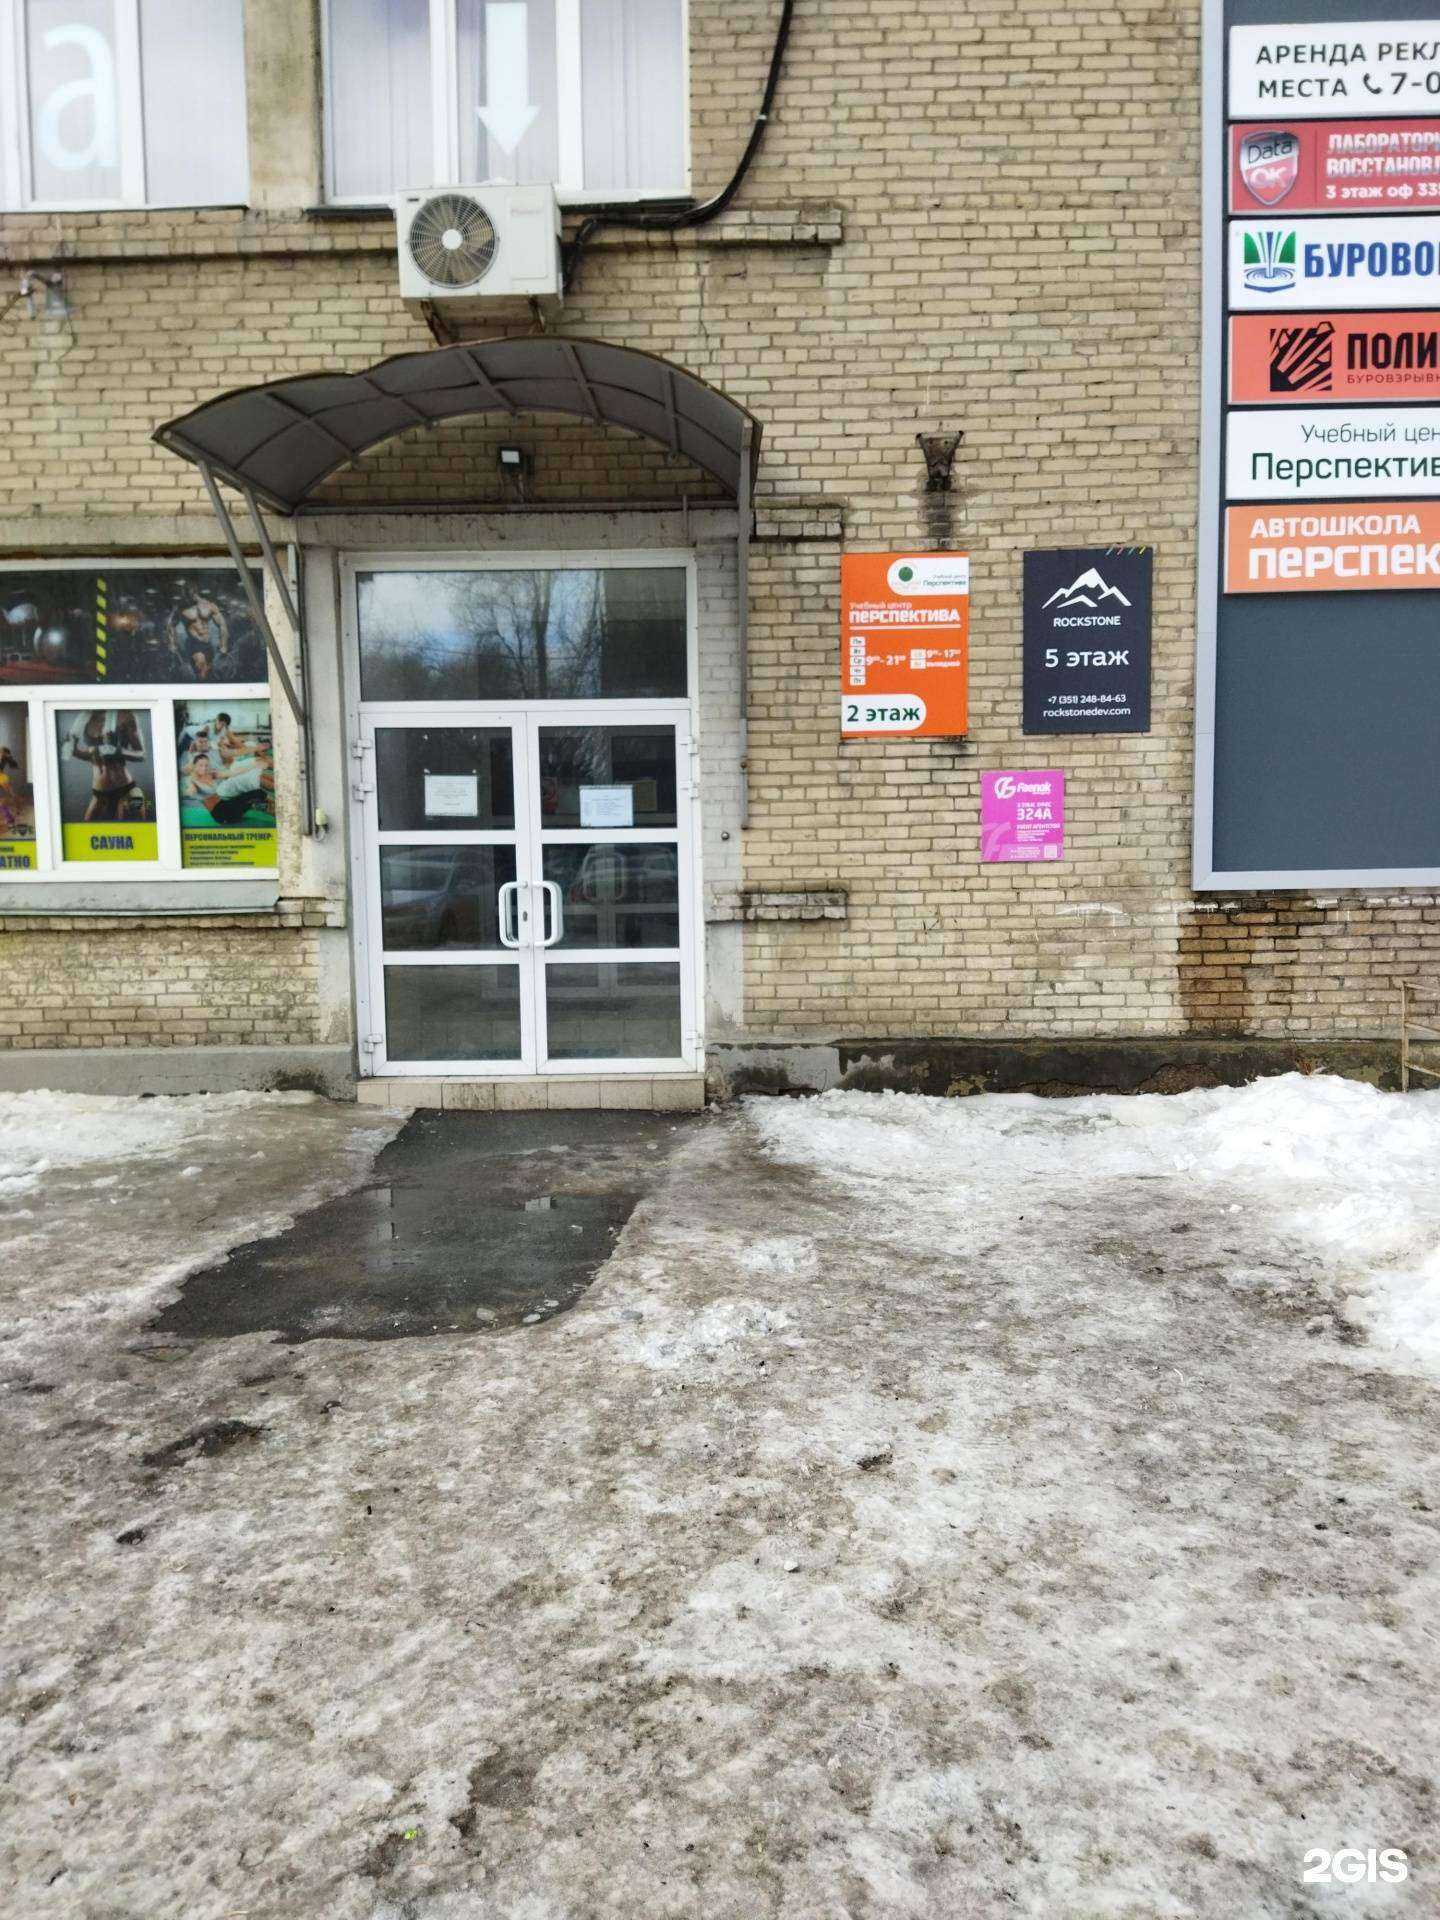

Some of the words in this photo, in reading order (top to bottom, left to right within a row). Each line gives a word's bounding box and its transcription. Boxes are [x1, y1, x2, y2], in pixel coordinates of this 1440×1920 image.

[1256, 43, 1367, 66] АРЕНДА
[1258, 78, 1348, 98] МЕСТА
[1248, 139, 1293, 165] Data
[1325, 185, 1337, 200] 3
[1341, 186, 1383, 199] этаж
[1387, 183, 1413, 200] оф
[1304, 240, 1440, 279] БУРОВО
[1301, 422, 1396, 444] Учебный
[1250, 514, 1421, 538] АВТОШКОЛА
[1053, 616, 1121, 627] ROCKSTONE
[1045, 648, 1059, 668] 5
[1066, 649, 1130, 667] этаж
[846, 704, 859, 722] 2
[866, 706, 920, 722] этаж
[1043, 707, 1132, 717] rockstonedev.com
[90, 835, 134, 851] САУНА
